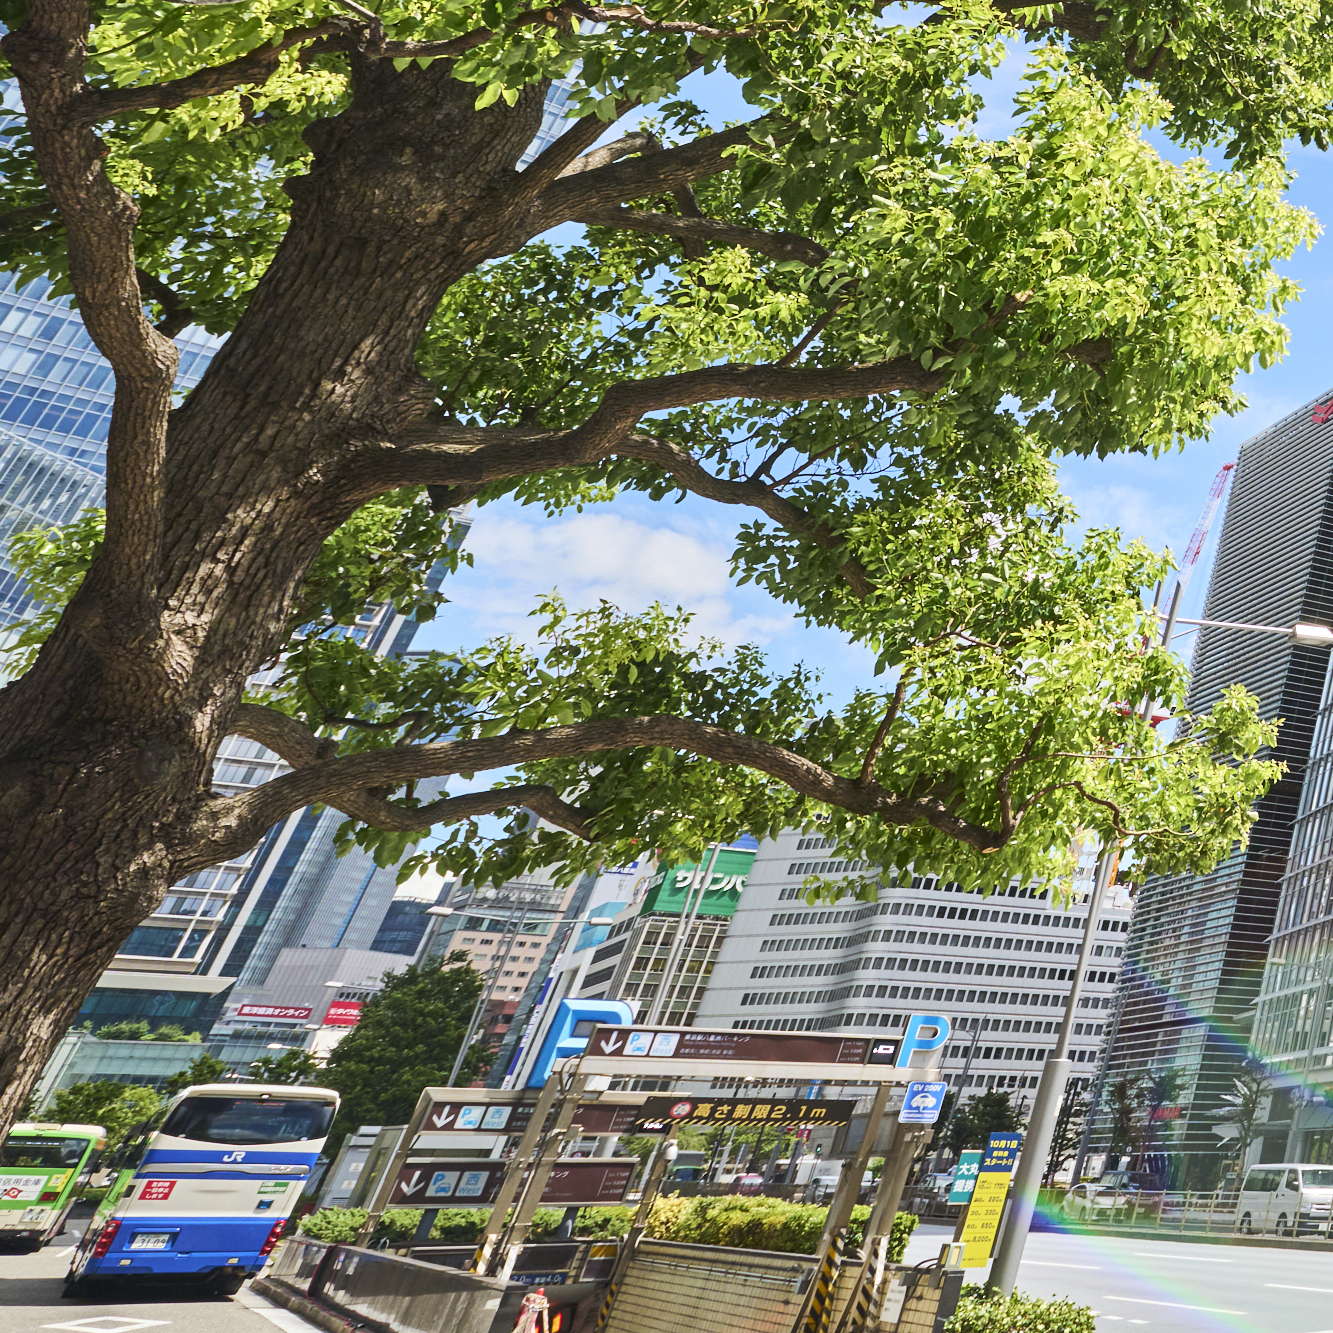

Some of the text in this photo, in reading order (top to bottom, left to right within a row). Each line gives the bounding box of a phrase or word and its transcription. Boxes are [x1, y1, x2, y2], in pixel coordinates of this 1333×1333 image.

[913, 1083, 943, 1092] EV 200V
[484, 1119, 505, 1128] West
[990, 1140, 1018, 1148] 10月1日
[222, 1151, 246, 1163] JR
[957, 1162, 979, 1176] 大丸
[458, 1185, 481, 1195] West
[952, 1179, 976, 1193] 提携
